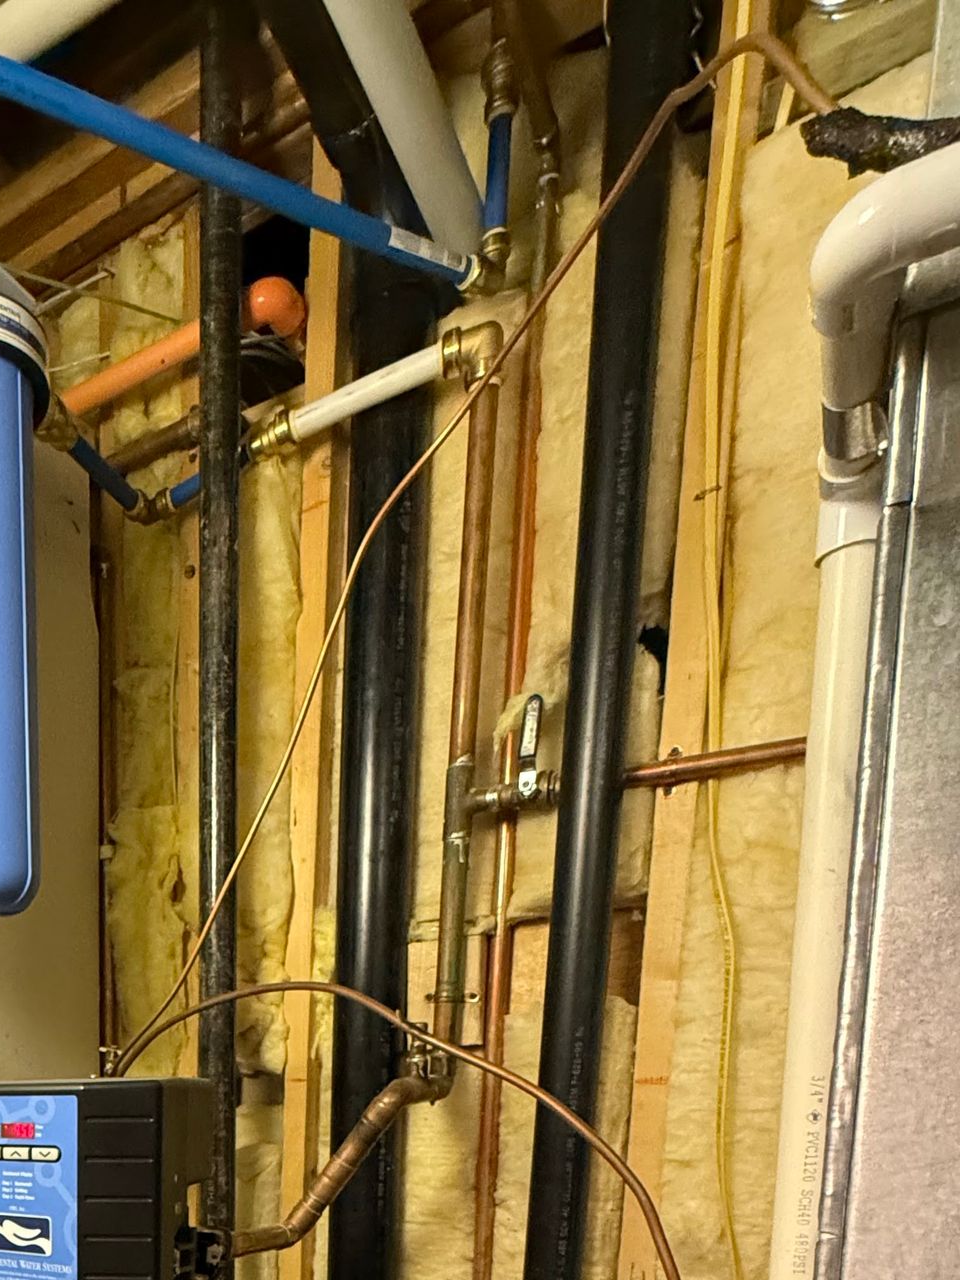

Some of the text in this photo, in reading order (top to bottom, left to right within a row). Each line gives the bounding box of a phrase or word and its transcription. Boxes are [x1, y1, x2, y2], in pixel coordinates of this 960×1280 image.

[809, 1074, 825, 1103] 3/4"
[802, 1131, 820, 1183] PVC1120
[796, 1189, 813, 1226] SCH40
[18, 1259, 42, 1272] WATER
[41, 1263, 73, 1275] SYSTEMS
